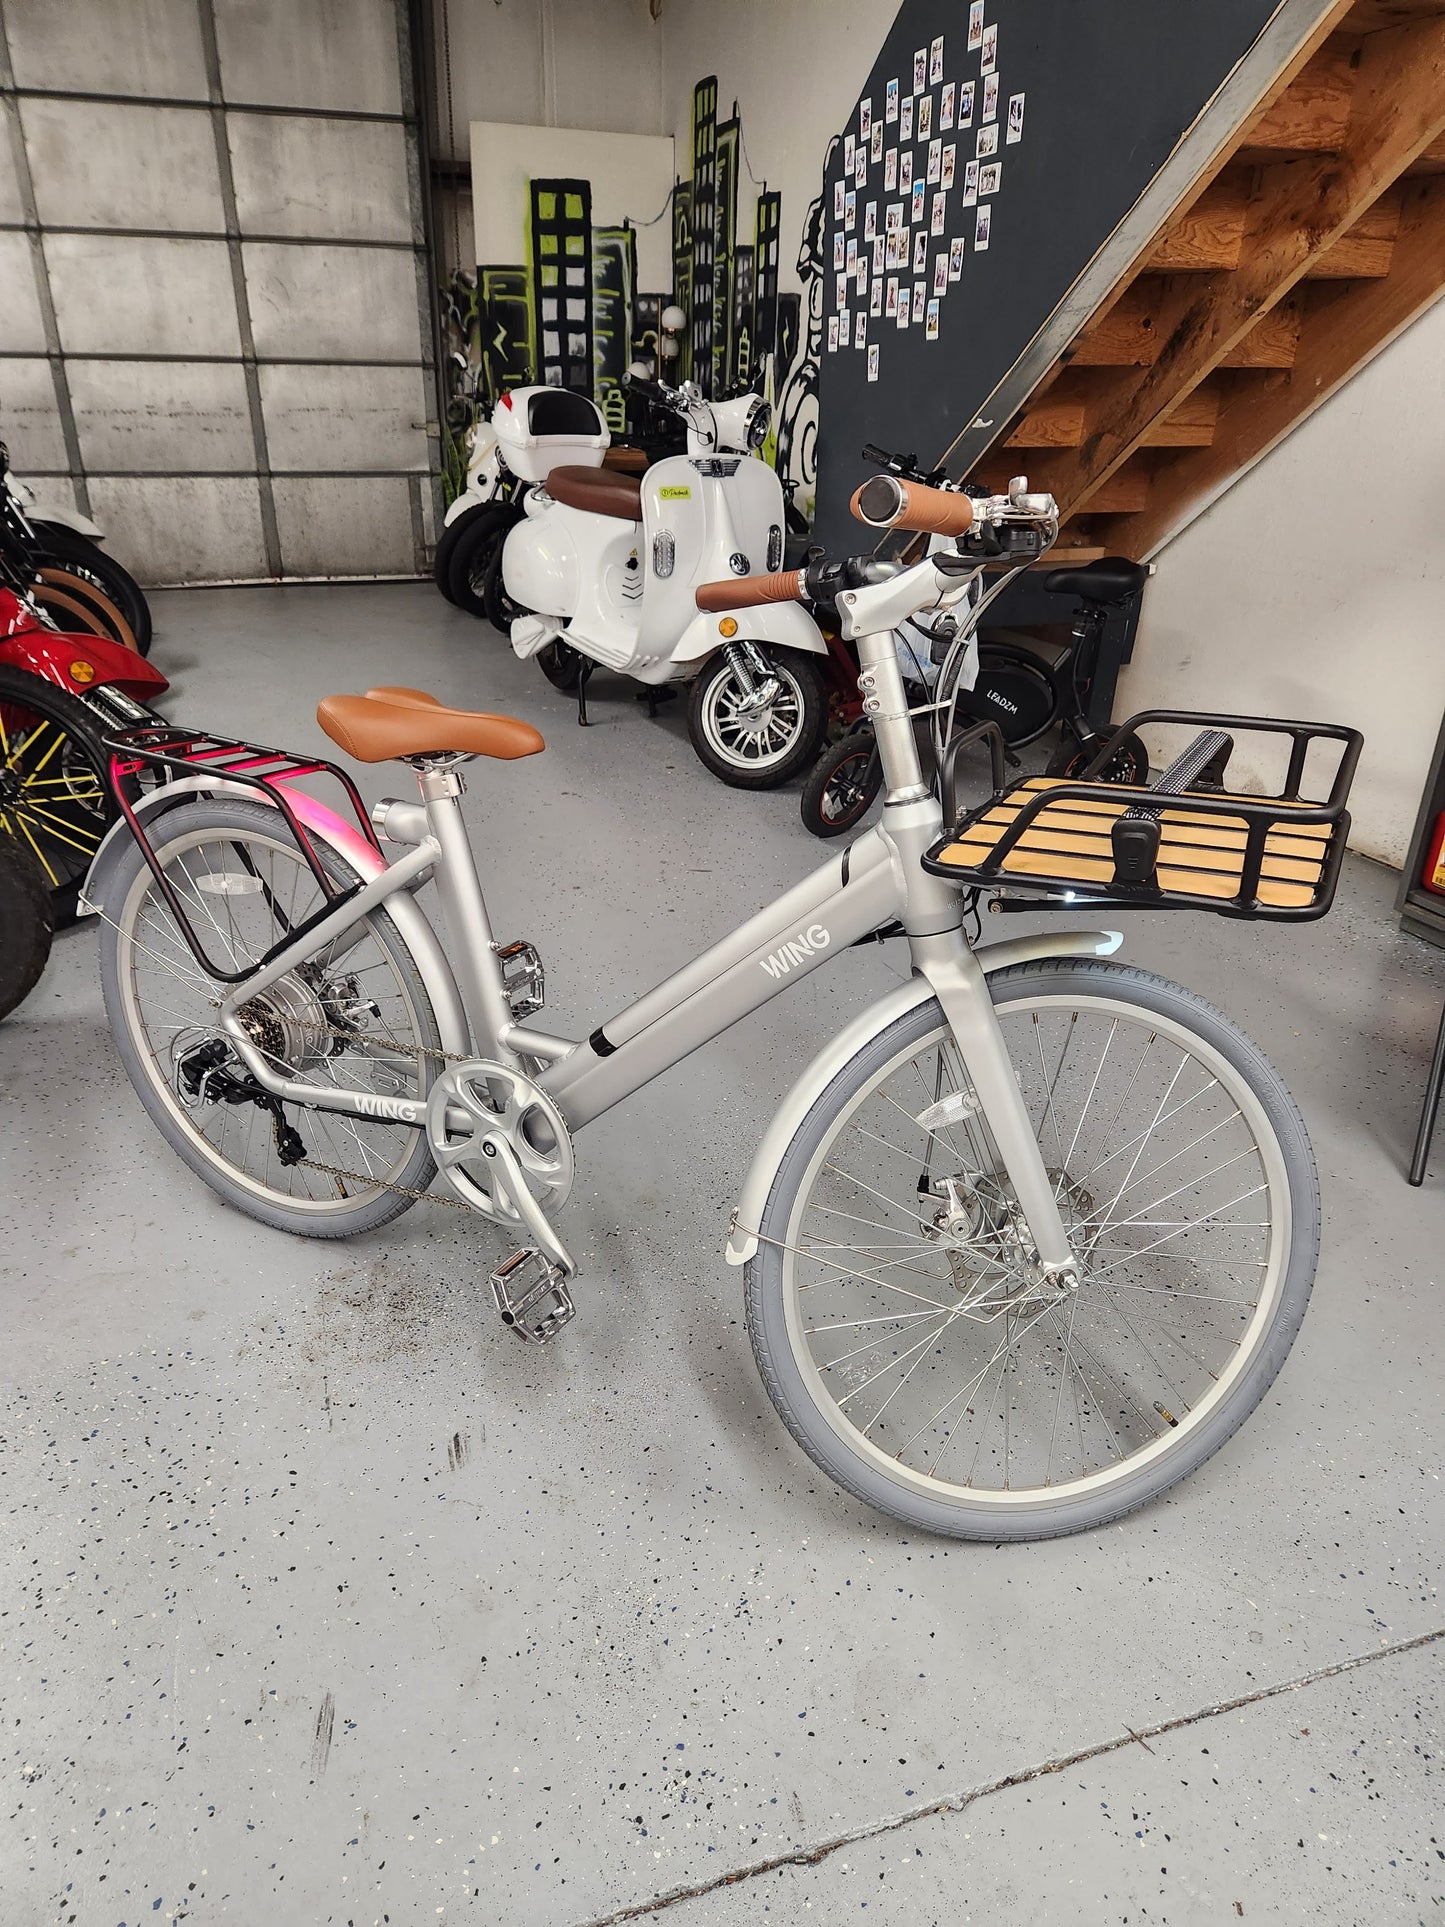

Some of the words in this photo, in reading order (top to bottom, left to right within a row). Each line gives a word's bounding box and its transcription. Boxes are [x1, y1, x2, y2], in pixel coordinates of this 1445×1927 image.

[986, 689, 1018, 715] LEADZM
[760, 924, 830, 979] WING
[354, 1096, 417, 1122] WING
